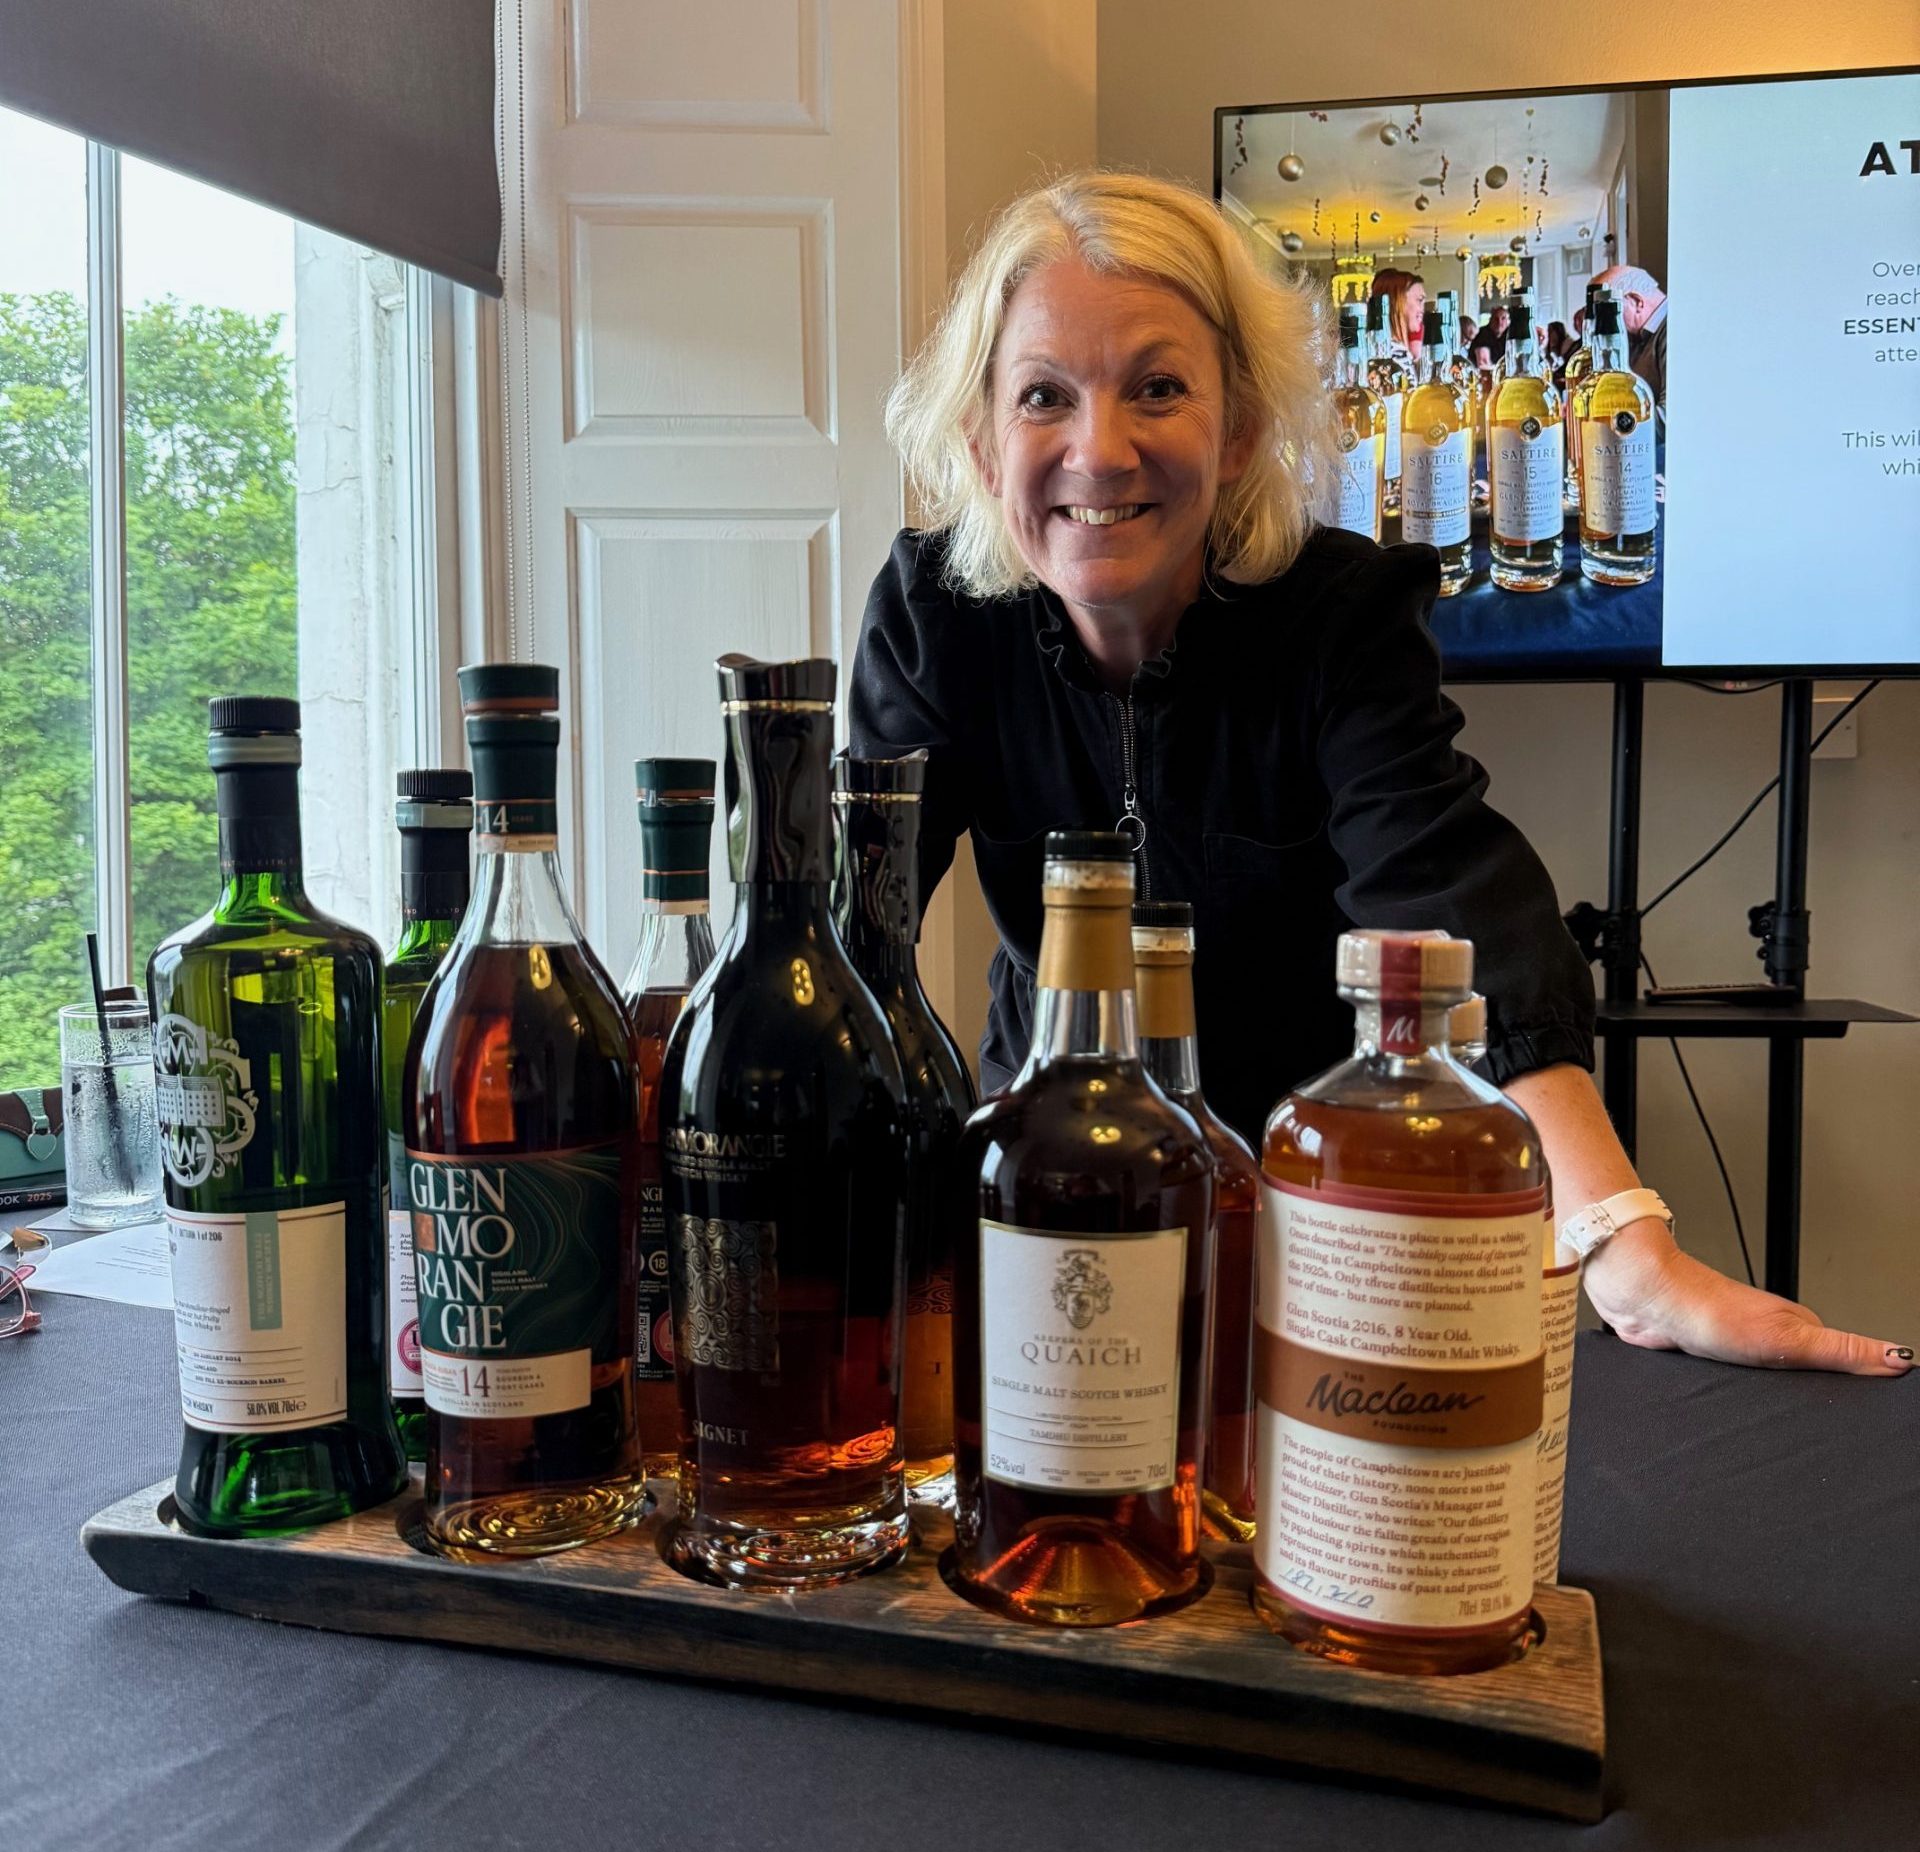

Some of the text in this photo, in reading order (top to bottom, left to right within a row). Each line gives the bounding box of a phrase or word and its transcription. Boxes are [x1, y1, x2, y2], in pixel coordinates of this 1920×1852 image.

[1844, 317, 1920, 335] ESSEN
[1502, 448, 1556, 460] SALTIRE
[1595, 443, 1649, 455] SALTIRE
[1841, 430, 1885, 448] This
[1409, 454, 1463, 466] SALTIRE
[1524, 466, 1537, 480] 15
[1430, 472, 1442, 486] 16
[481, 805, 509, 833] 14
[1387, 1016, 1415, 1043] M
[27, 1192, 52, 1202] 2025
[410, 1163, 507, 1213] GLEN
[436, 1213, 516, 1260] MO
[1290, 1210, 1491, 1244] This bottle celebrates a place as well as
[1288, 1243, 1514, 1278] distilling in Campbeltown almost died out
[1289, 1226, 1310, 1241] Once
[1312, 1233, 1361, 1251] described
[1363, 1246, 1375, 1254] as
[1407, 1249, 1447, 1262] whisky
[1448, 1251, 1483, 1264] capital
[1483, 1250, 1495, 1263] of
[1494, 1250, 1506, 1260] the
[417, 1252, 484, 1303] RAN
[653, 1257, 667, 1270] 18
[1288, 1259, 1301, 1271] the
[1335, 1270, 1362, 1287] Only
[1365, 1275, 1396, 1290] three
[1398, 1280, 1460, 1295] distilleries
[1463, 1283, 1487, 1295] have
[1488, 1281, 1512, 1294] stood
[1514, 1280, 1525, 1290] the
[1288, 1275, 1474, 1312] test of time but more are planned.
[440, 1303, 507, 1349] GIE
[1286, 1318, 1480, 1360] Single Cask Campbeltown Malt
[1287, 1302, 1472, 1342] Glen Scotia 8 Year Old.
[1021, 1341, 1141, 1365] QUAICH
[1034, 1334, 1128, 1346] KEEPERS OF THE
[459, 1364, 491, 1398] 14
[992, 1376, 1168, 1400] SINGLE MALT SCOTCH WHISKY
[1344, 1371, 1365, 1383] THE
[1305, 1372, 1486, 1417] Maclean
[692, 1420, 750, 1446] SIGNET
[1073, 1432, 1128, 1443] DISTILLERY
[1147, 1463, 1167, 1478] 70cl
[1282, 1451, 1482, 1495] proud of their history, none more so
[1283, 1433, 1511, 1481] The people of Campbeltown are justifiably
[1282, 1482, 1312, 1503] Master
[1313, 1495, 1361, 1520] Distiller,
[1365, 1511, 1390, 1524] who
[1393, 1515, 1435, 1528] writes:
[1468, 1513, 1509, 1528] distillery
[1297, 1474, 1346, 1500] McAlister,
[1349, 1490, 1378, 1505] Glen
[1381, 1495, 1429, 1512] Scotia's
[1432, 1500, 1483, 1513] Manager
[1485, 1496, 1502, 1508] and
[1280, 1513, 1500, 1561] by producing spirits which authentically
[1281, 1501, 1299, 1516] aims
[1301, 1509, 1310, 1520] to
[1312, 1511, 1350, 1532] honour
[1353, 1524, 1373, 1537] the
[1374, 1529, 1409, 1542] fallen
[1410, 1532, 1447, 1545] greats
[1450, 1532, 1464, 1544] of
[1464, 1534, 1481, 1543] our
[1279, 1548, 1465, 1595] and its flavour profiles of past and
[1280, 1531, 1501, 1579] represent our town, its whisky character
